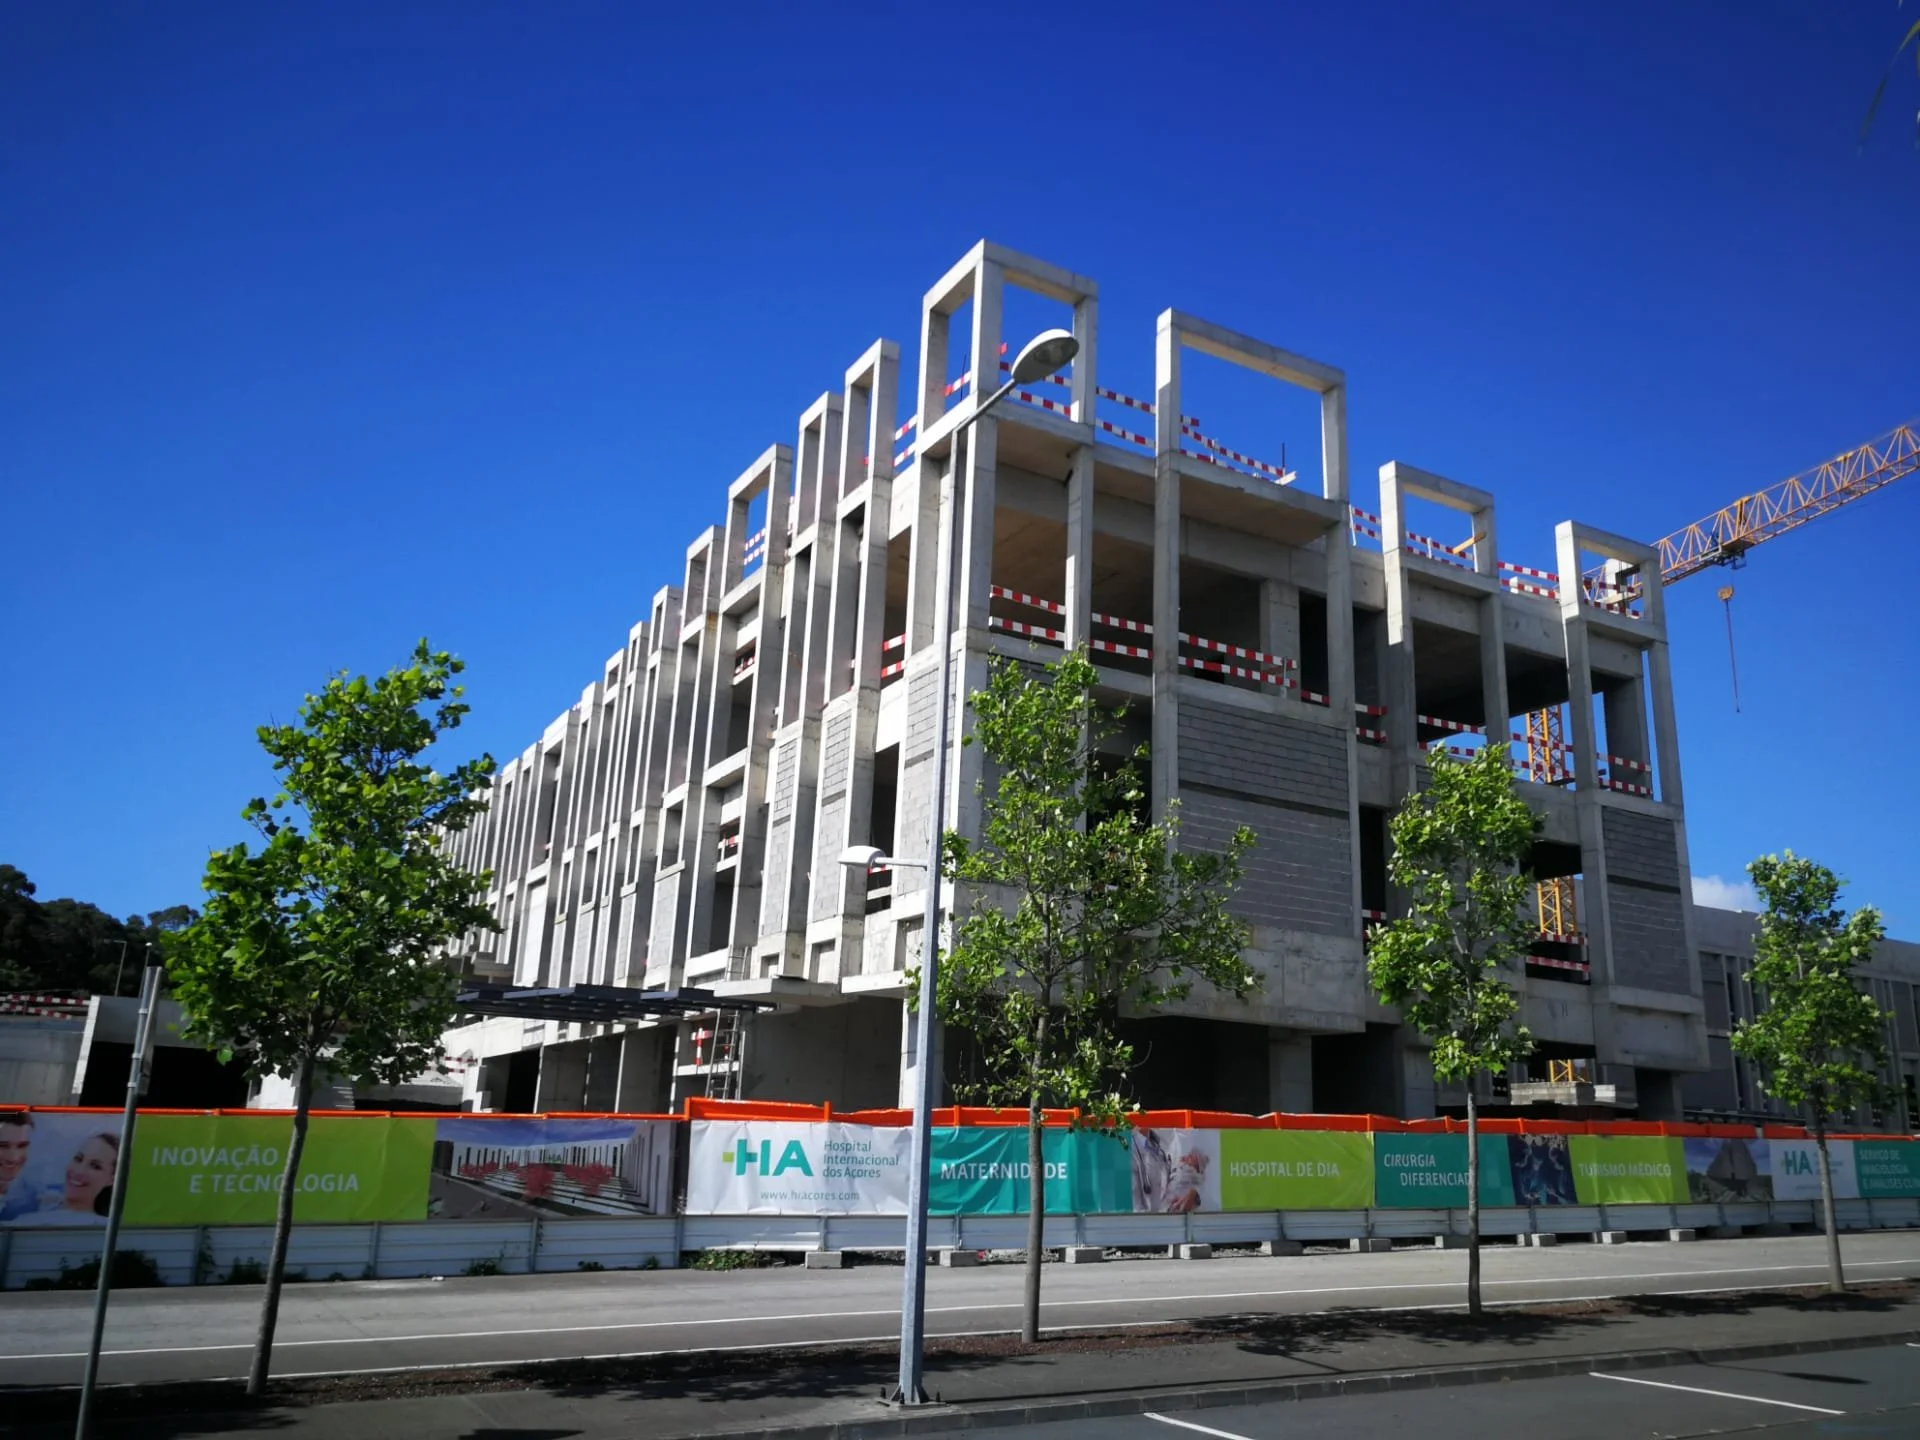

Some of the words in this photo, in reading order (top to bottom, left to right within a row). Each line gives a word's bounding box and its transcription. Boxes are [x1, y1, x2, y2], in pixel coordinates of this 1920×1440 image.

[823, 1140, 872, 1154] Hospital
[151, 1144, 279, 1170] INOVAÇÃO
[823, 1154, 900, 1166] Internacional
[1383, 1153, 1437, 1168] CIRURGIA
[822, 1166, 842, 1178] dos
[843, 1166, 881, 1179] Açores
[940, 1162, 1068, 1180] MATERNIDDE
[1230, 1161, 1292, 1177] HOSPITAL
[1296, 1161, 1314, 1177] DE
[1317, 1161, 1340, 1177] DIA
[189, 1174, 203, 1193] E
[760, 1190, 861, 1201] www.hiacores.com
